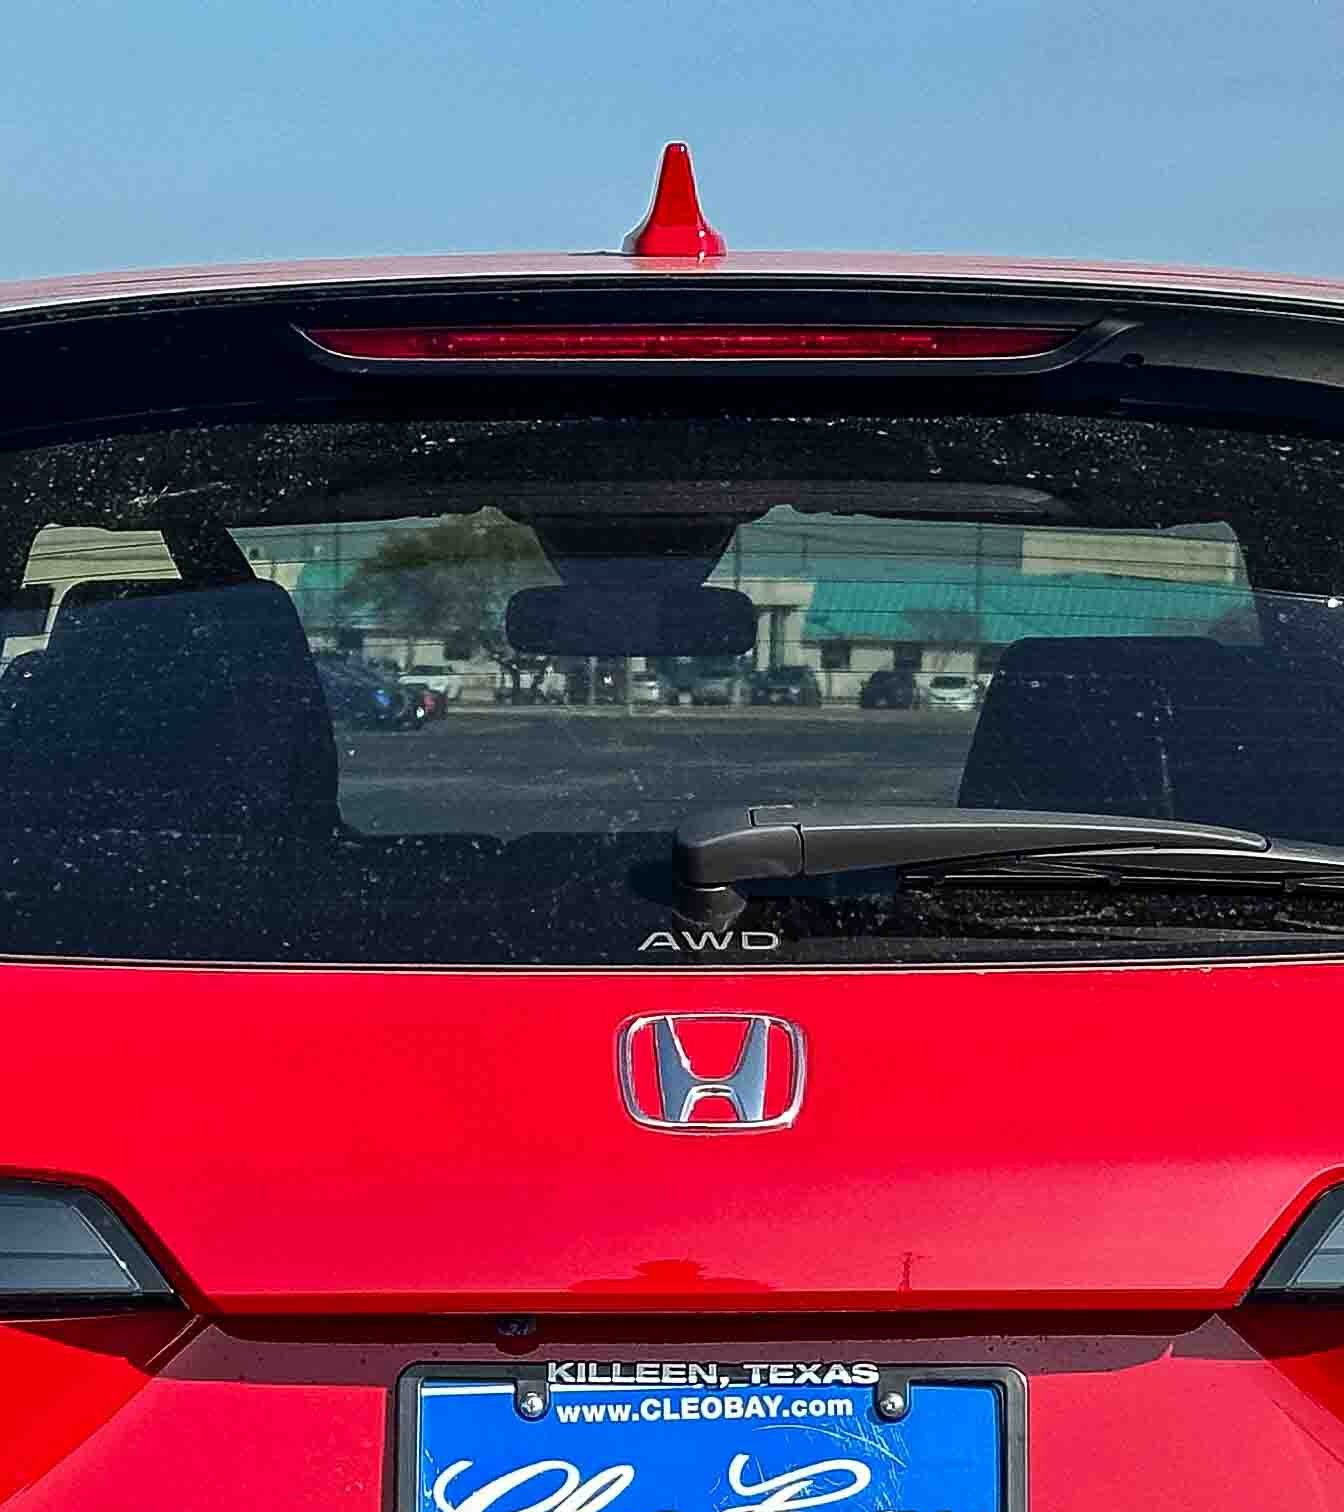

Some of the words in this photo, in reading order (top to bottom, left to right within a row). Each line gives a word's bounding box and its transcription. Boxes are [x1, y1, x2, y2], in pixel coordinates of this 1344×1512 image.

[637, 931, 780, 951] AWD
[547, 1362, 730, 1389] KILLEEN,
[742, 1363, 879, 1384] TEXAS
[556, 1395, 853, 1423] www.CLEOBAY.com
